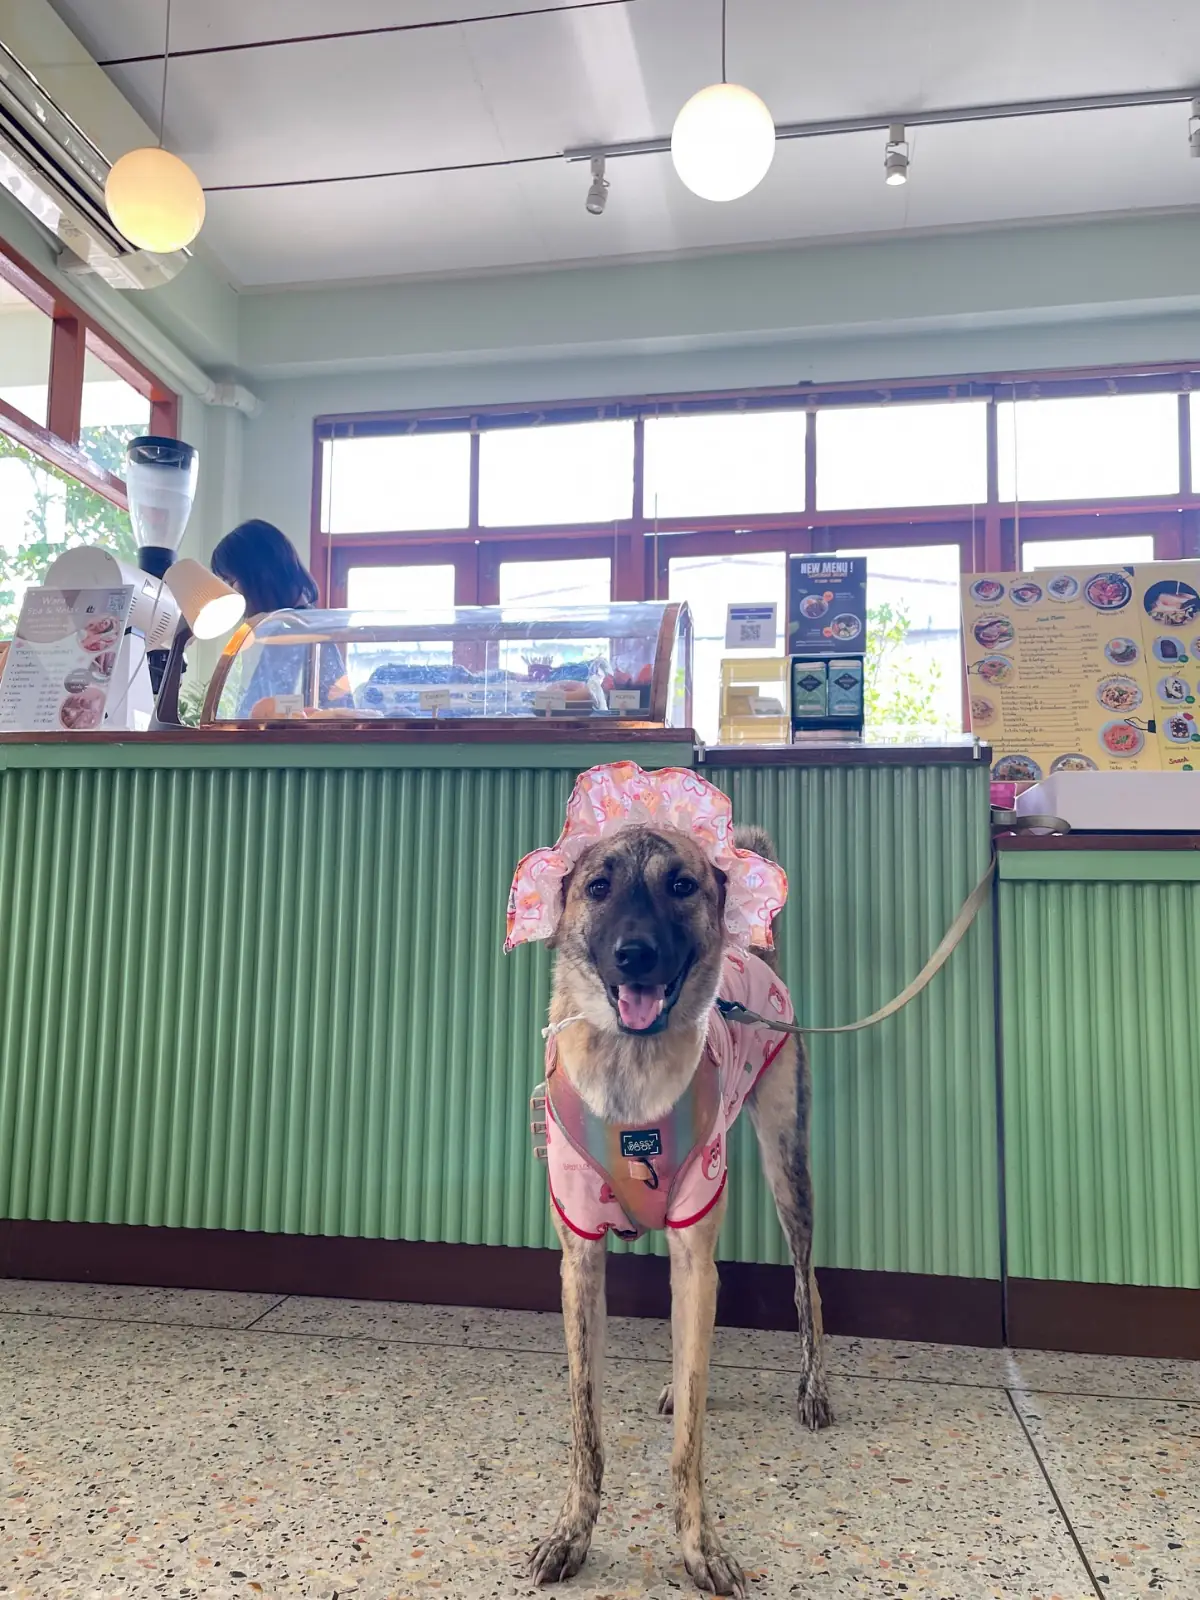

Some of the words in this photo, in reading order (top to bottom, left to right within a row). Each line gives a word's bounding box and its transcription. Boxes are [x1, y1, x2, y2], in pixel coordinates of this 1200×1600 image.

[800, 562, 820, 574] NEW
[822, 561, 848, 573] MENU
[627, 1139, 655, 1147] SASSY
